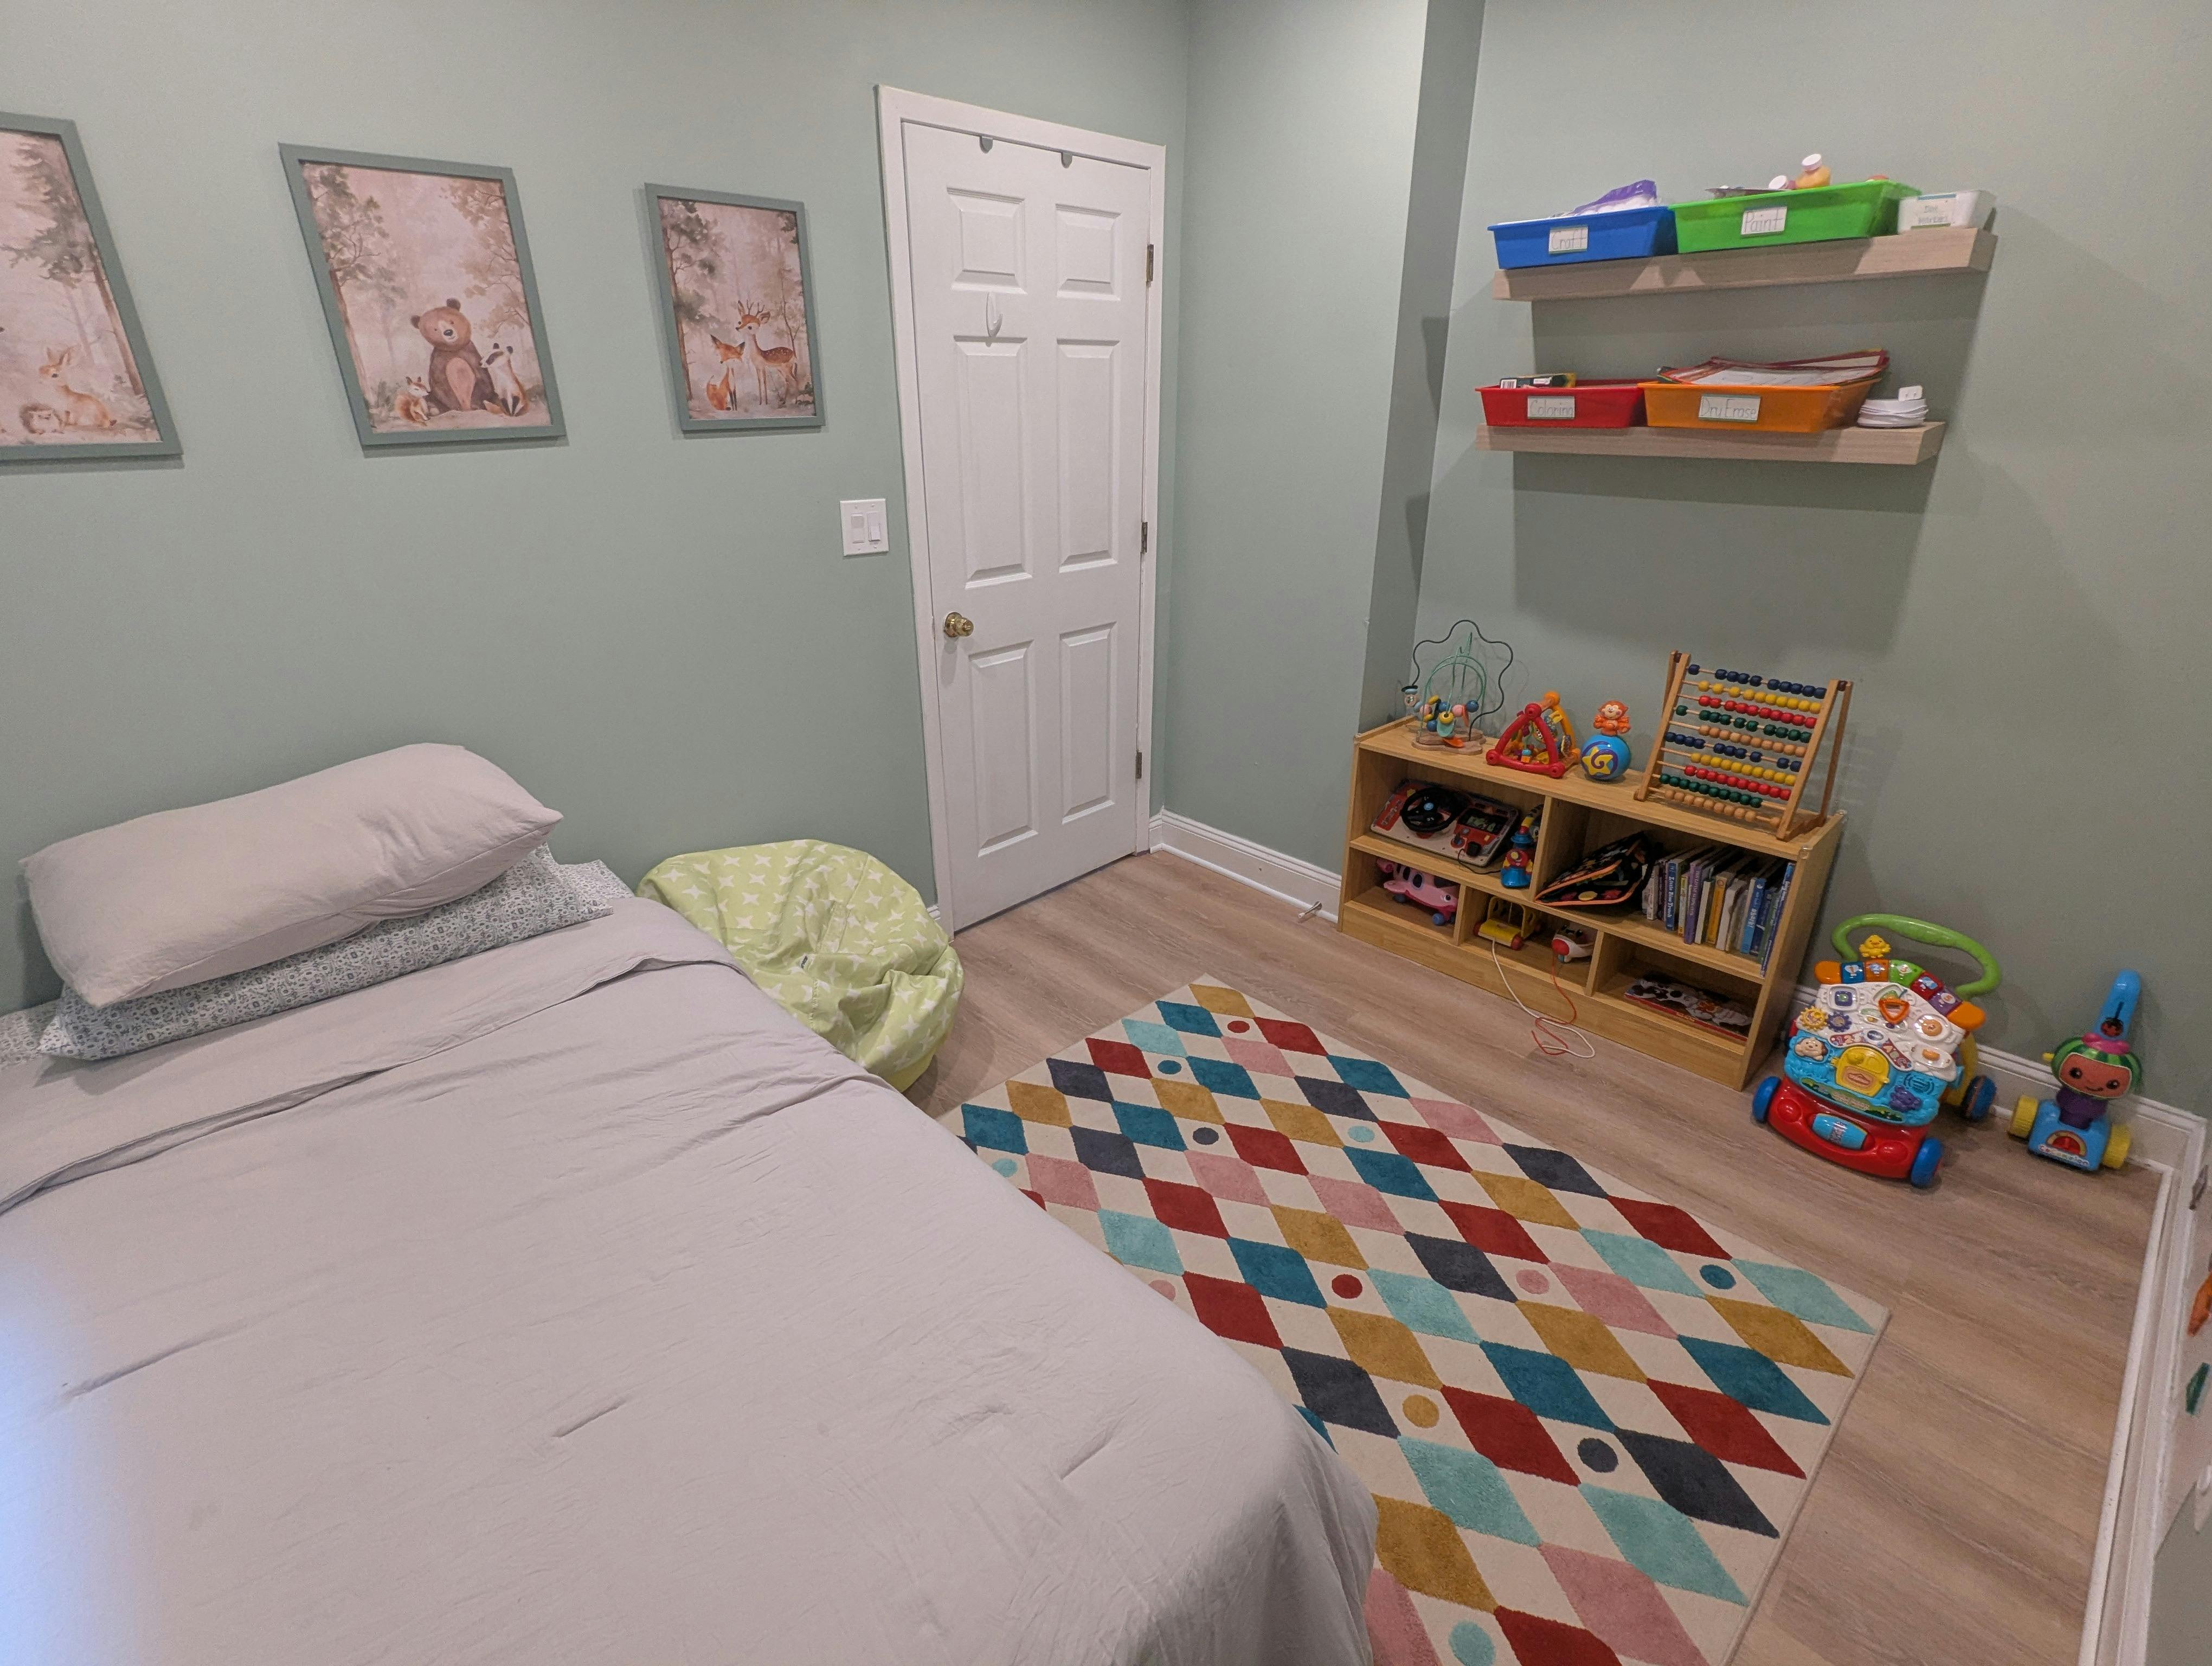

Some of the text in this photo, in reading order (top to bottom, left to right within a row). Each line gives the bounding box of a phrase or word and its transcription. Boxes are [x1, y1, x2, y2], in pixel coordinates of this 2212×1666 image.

[1745, 208, 1783, 233] Paint
[1551, 229, 1586, 249] Craft
[1530, 400, 1573, 416] Coloring
[1725, 399, 1756, 419] Erase
